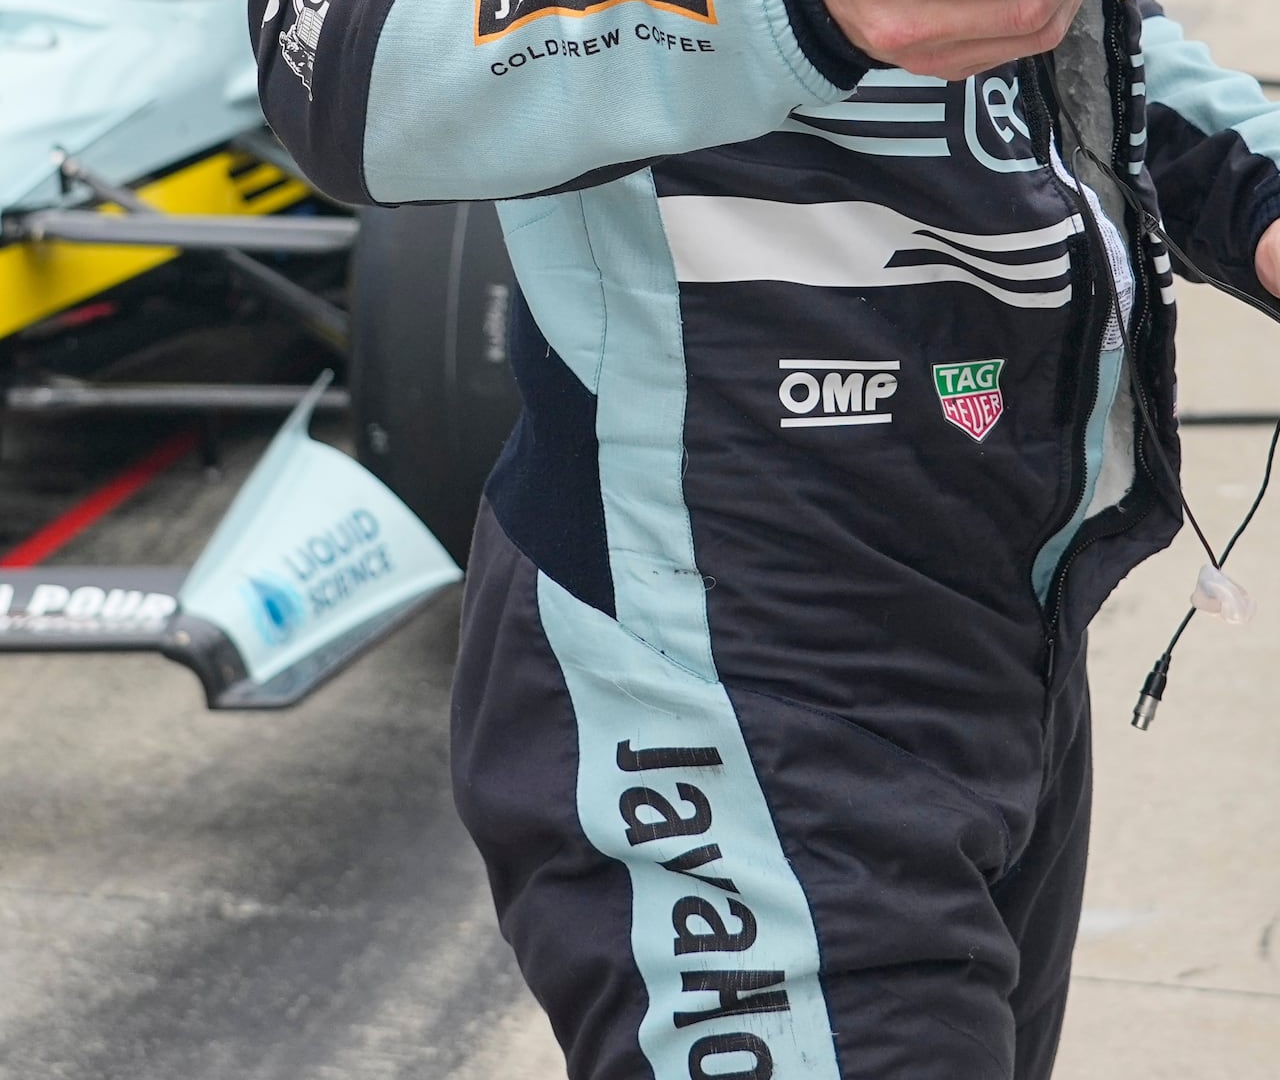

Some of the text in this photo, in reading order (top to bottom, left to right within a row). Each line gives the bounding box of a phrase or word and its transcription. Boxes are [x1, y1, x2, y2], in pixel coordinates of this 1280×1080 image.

[491, 23, 715, 76] COLD BREW COFFEE
[778, 372, 898, 415] OMP
[939, 364, 997, 393] TAG
[944, 393, 1002, 439] HEUER
[283, 508, 380, 582] LIQUID
[26, 584, 178, 623] POUR
